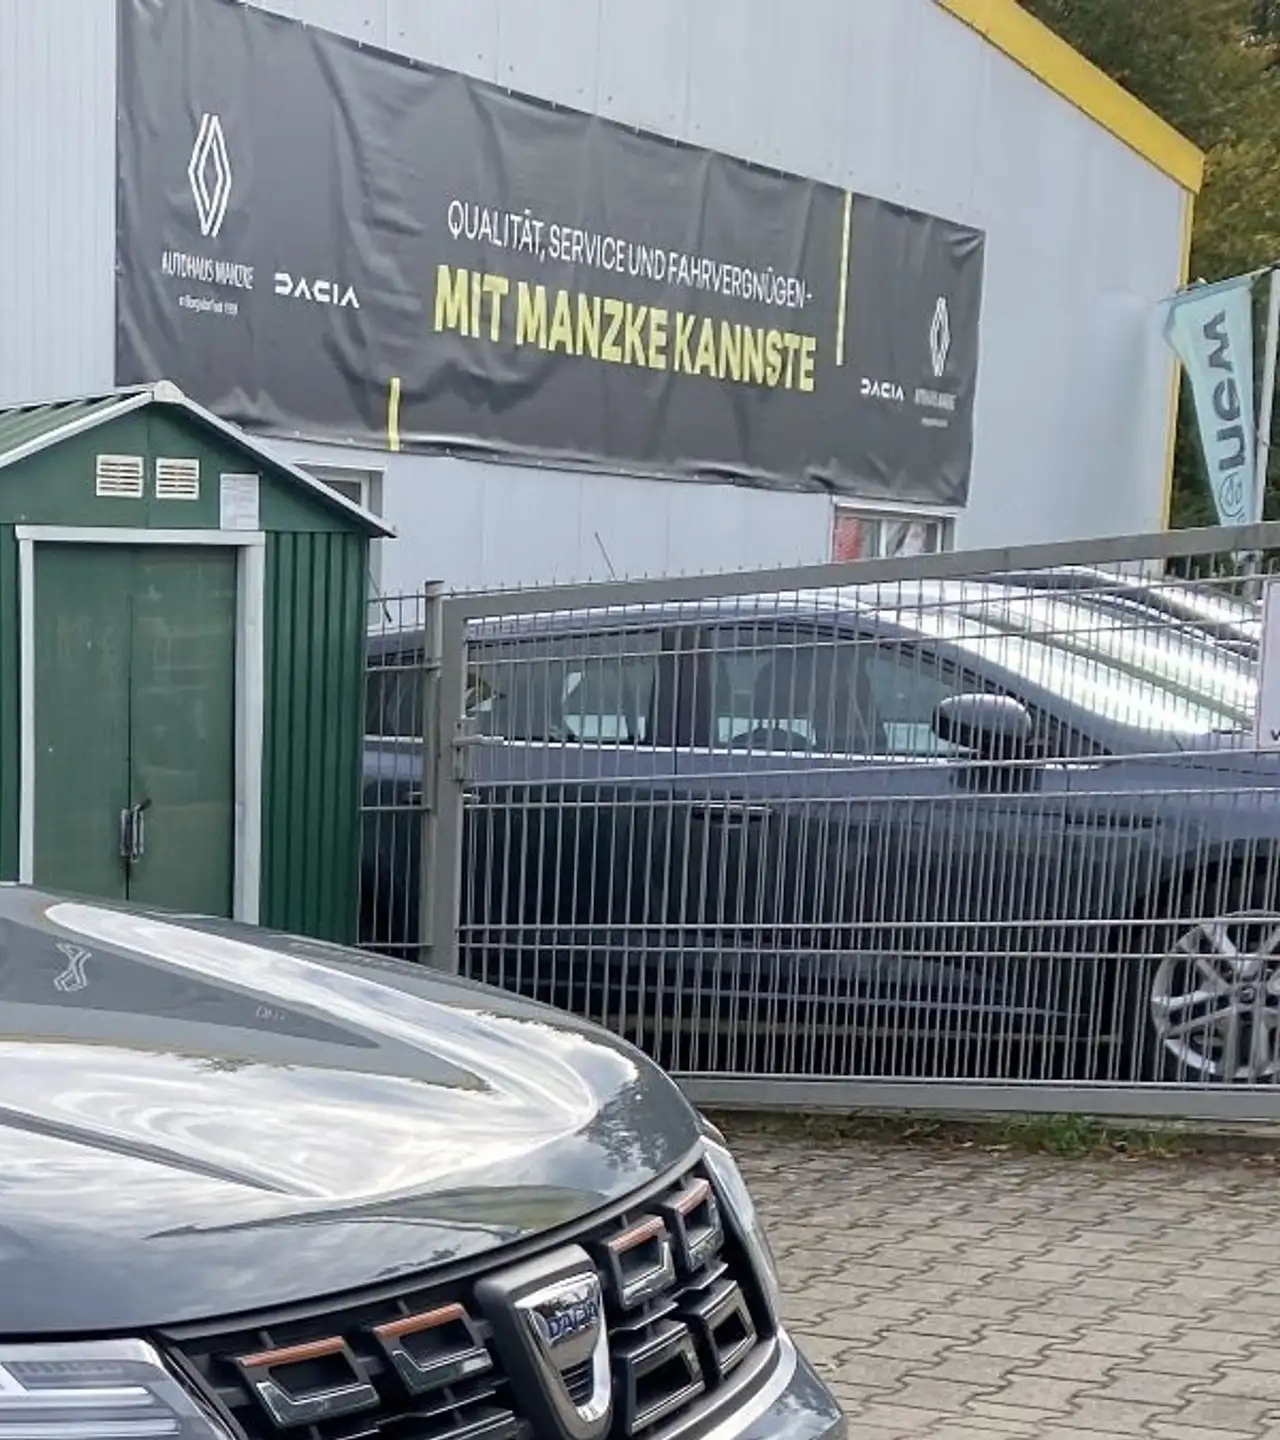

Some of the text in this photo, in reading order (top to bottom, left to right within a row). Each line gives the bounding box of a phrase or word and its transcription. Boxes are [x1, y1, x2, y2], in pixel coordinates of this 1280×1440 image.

[448, 200, 545, 262] QUALITÄT,
[549, 224, 626, 272] SERVICE
[628, 243, 666, 281] UND
[274, 272, 360, 309] DACIA
[435, 265, 817, 392] MIT MANZKE KANNSTE
[860, 378, 904, 402] DACIA
